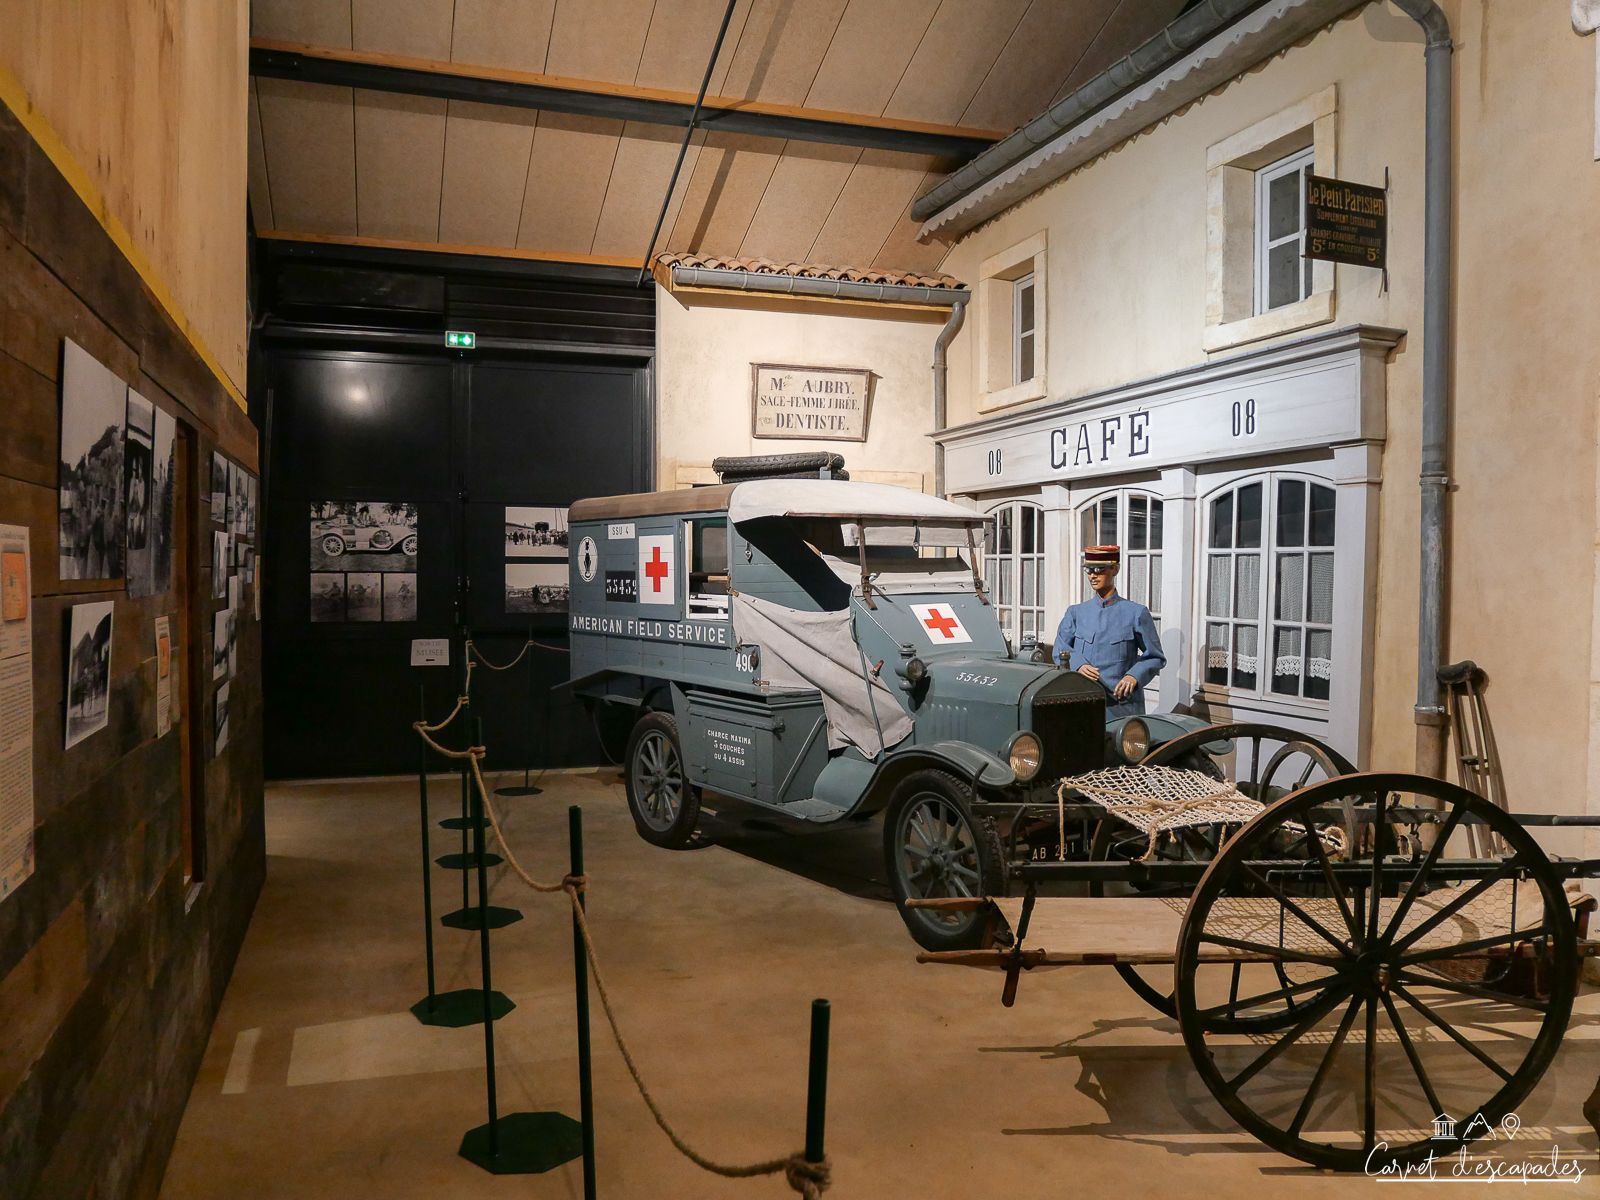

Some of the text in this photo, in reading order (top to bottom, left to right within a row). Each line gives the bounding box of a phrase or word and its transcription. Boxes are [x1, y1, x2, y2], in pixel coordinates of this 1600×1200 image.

[1308, 182, 1384, 216] Le Petit Parisien
[775, 412, 850, 431] DENTISTE.
[1232, 399, 1256, 437] 08
[1050, 407, 1150, 470] CAFÉ
[988, 448, 1002, 475] 08
[572, 616, 726, 644] AMERICAN FIELD SERVICE
[730, 735, 751, 745] MAXIMA
[1032, 847, 1047, 861] AB
